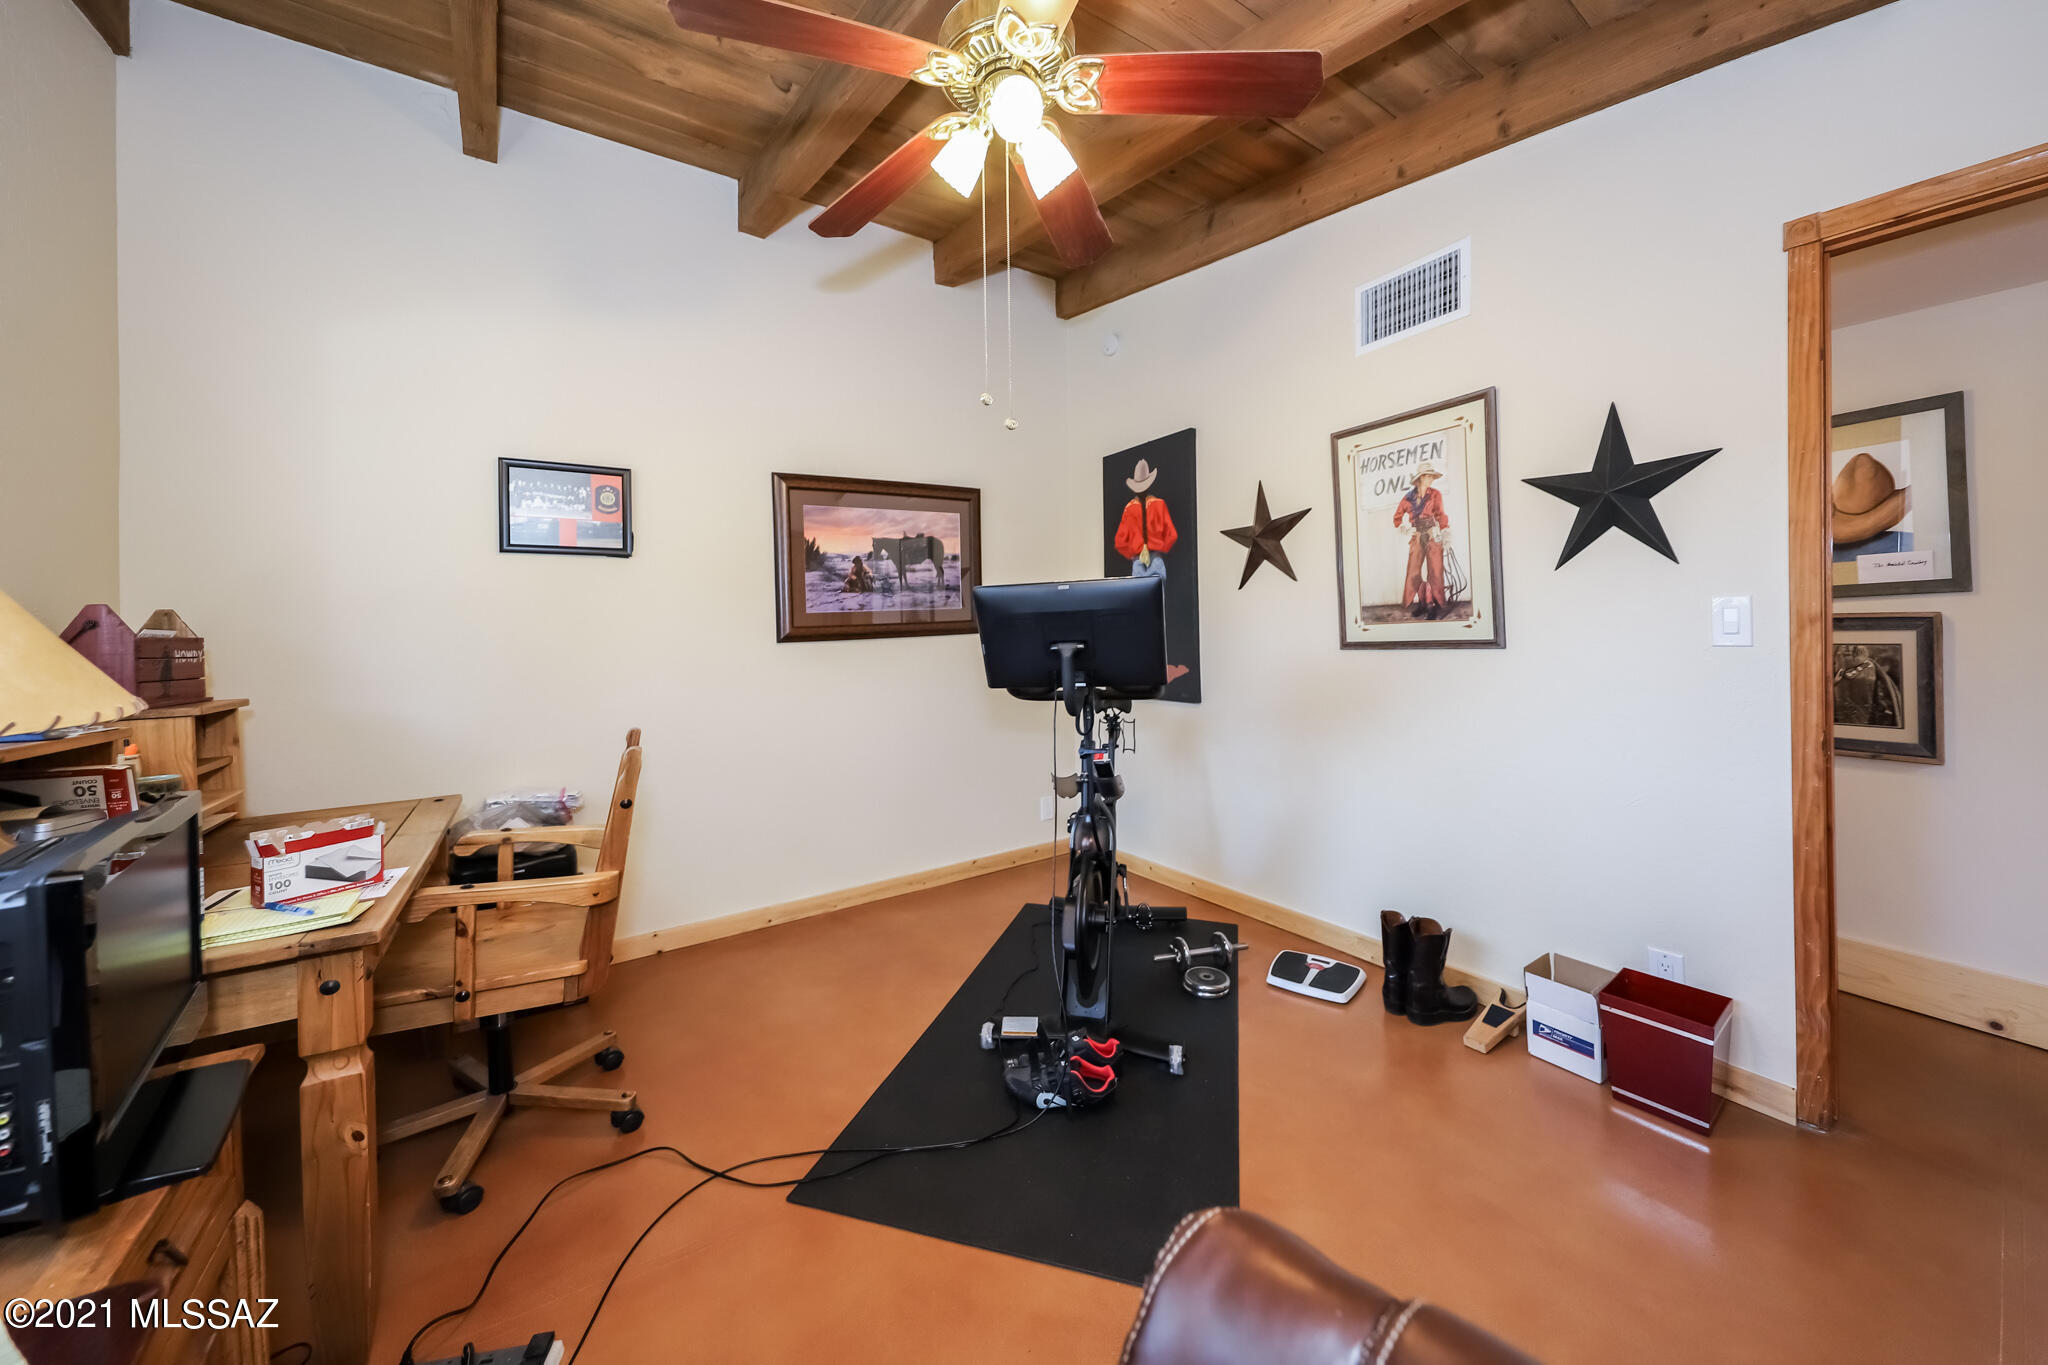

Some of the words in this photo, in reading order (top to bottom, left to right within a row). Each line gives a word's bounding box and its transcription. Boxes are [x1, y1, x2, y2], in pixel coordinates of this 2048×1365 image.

[1360, 440, 1444, 475] HORSEMEN
[1374, 474, 1414, 496] ONL
[174, 649, 203, 663] HOWDY
[73, 785, 97, 798] 50
[268, 879, 292, 891] 100
